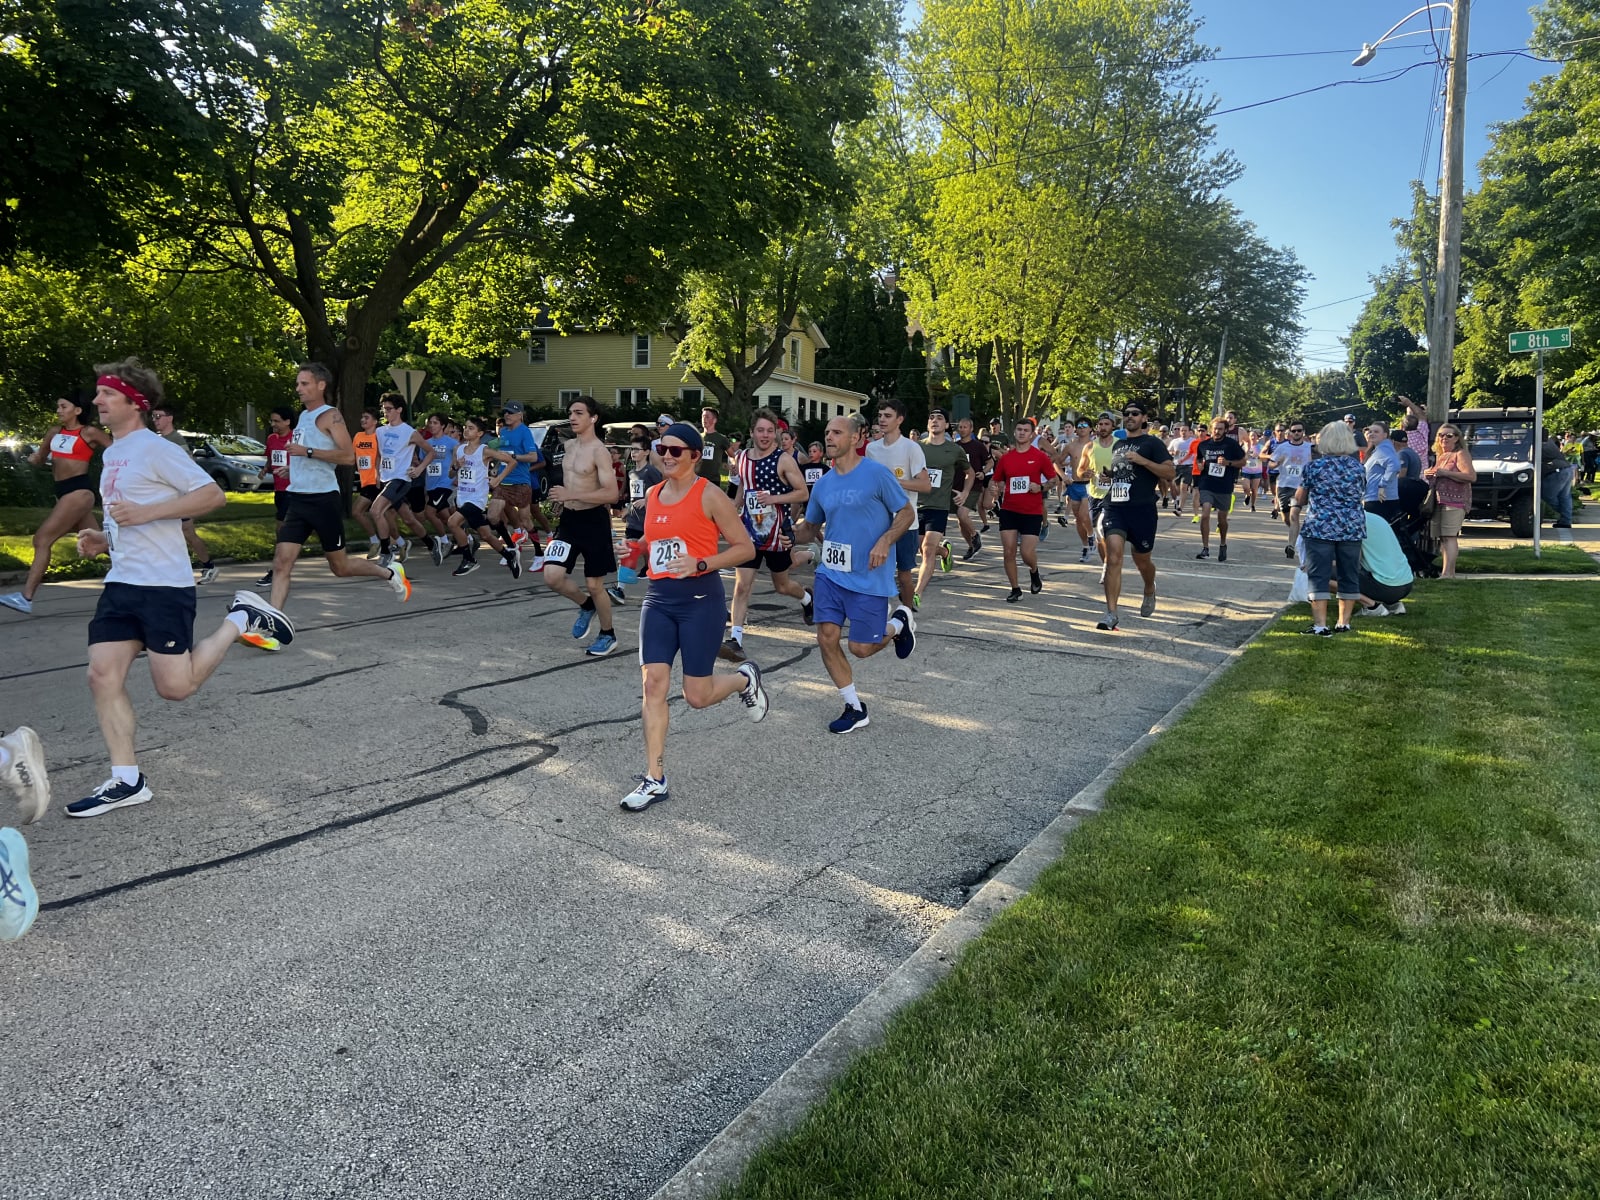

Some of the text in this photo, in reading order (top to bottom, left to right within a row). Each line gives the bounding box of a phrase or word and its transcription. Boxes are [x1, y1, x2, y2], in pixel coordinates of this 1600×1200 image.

[1528, 333, 1549, 348] 8th
[1561, 333, 1569, 342] St
[59, 438, 67, 448] 2
[460, 469, 473, 480] 551
[1012, 480, 1027, 491] 988
[1112, 486, 1128, 498] 1013
[546, 545, 565, 557] 180
[826, 548, 846, 566] 384
